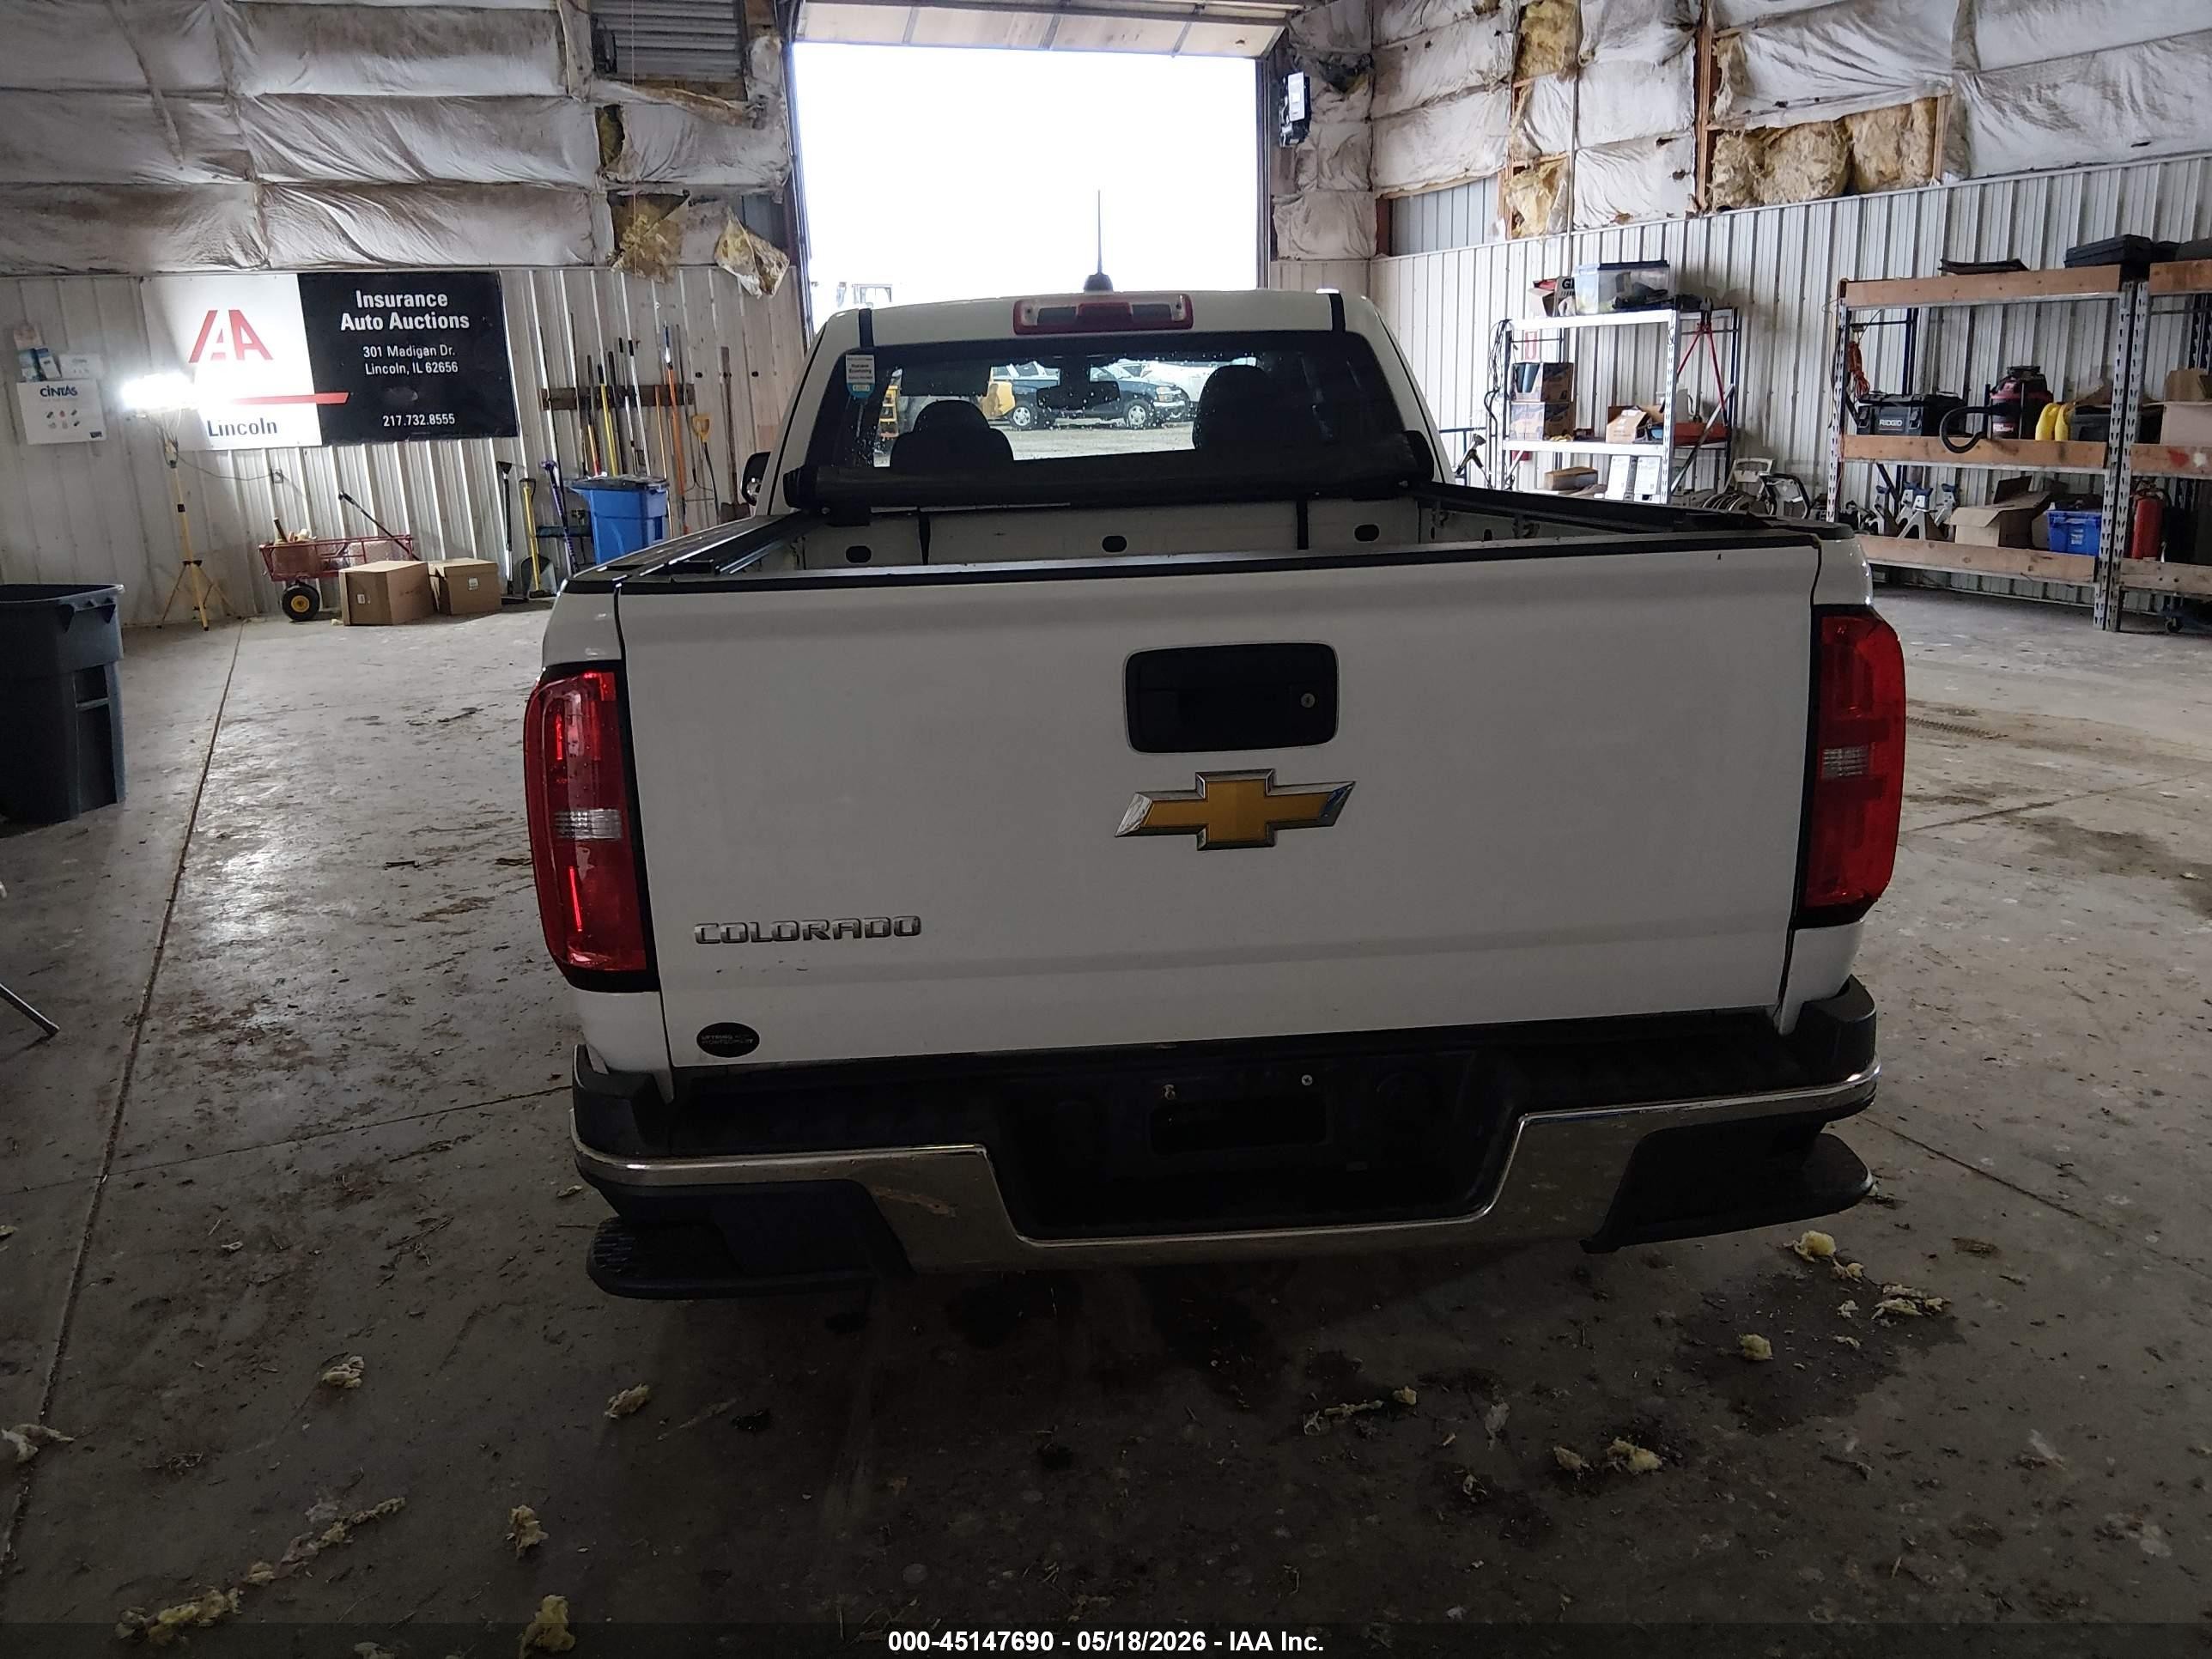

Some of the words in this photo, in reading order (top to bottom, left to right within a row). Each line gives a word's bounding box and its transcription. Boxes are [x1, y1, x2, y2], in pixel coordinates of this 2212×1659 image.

[356, 290, 448, 308] Insurance
[340, 313, 384, 331] Auto
[389, 312, 470, 330] Auctions
[362, 346, 382, 358] 301
[387, 344, 437, 359] Madigan
[440, 343, 455, 356] Dr.
[365, 362, 410, 376] Lincoln,
[412, 362, 423, 374] IL
[425, 362, 459, 374] 62656
[207, 417, 277, 437] Lincoln
[382, 413, 455, 427] 217.732.8555
[1879, 418, 1903, 427] RIDGID
[694, 915, 921, 944] COLORADO
